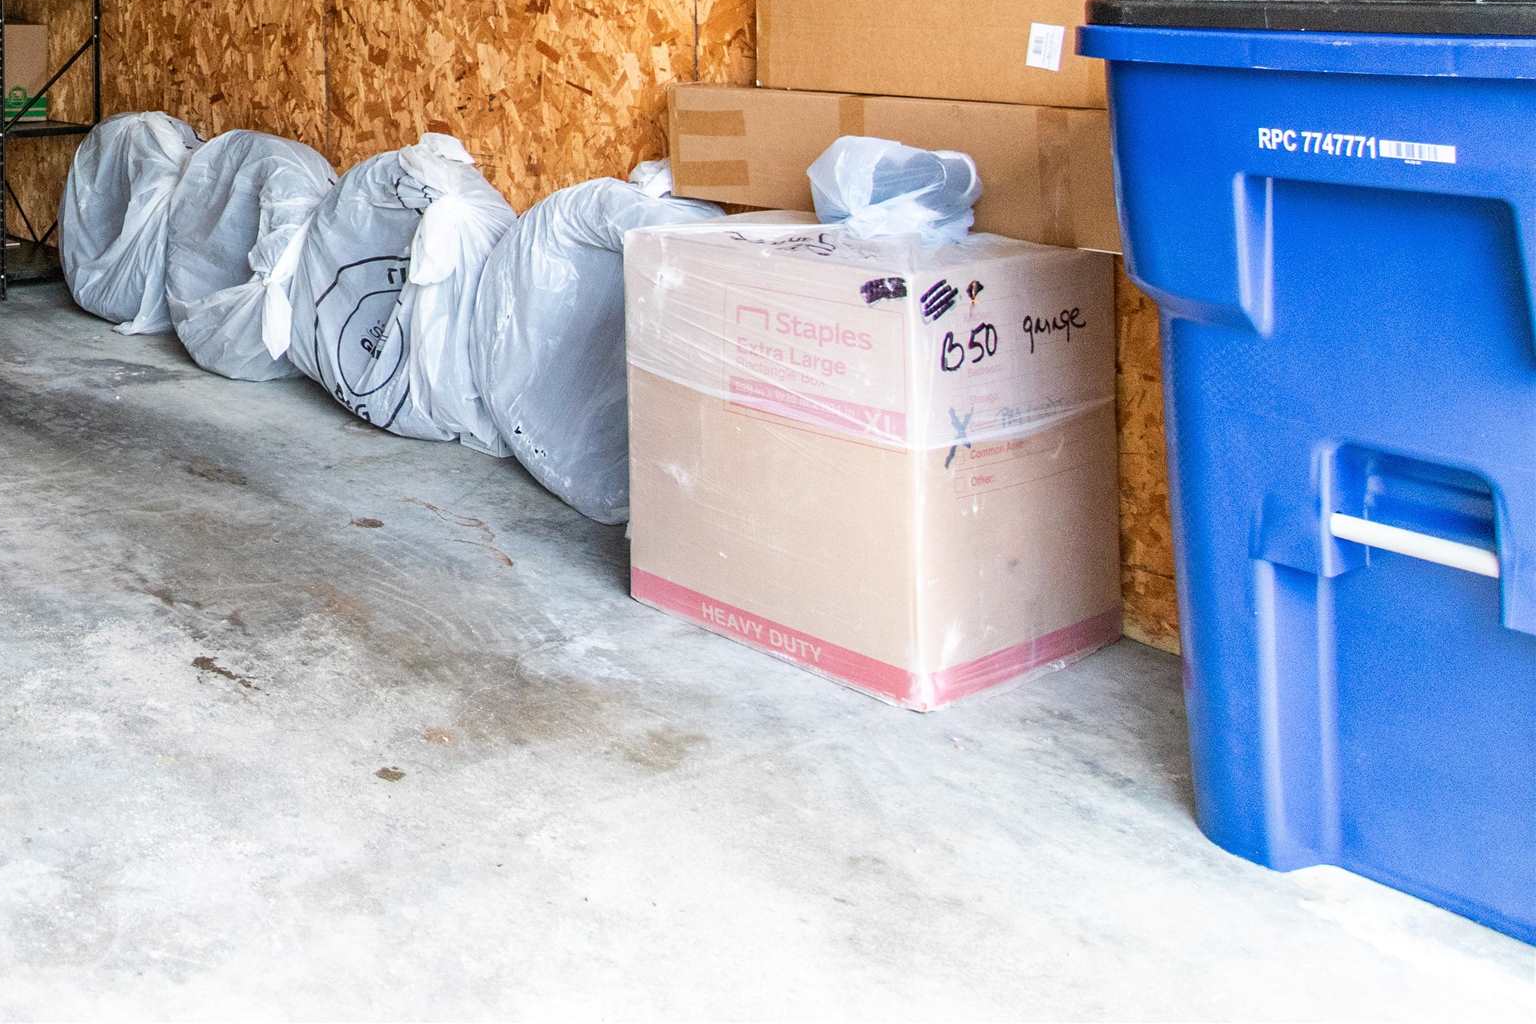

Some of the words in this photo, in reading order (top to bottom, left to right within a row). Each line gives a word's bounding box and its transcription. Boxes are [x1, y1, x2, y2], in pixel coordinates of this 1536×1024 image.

[1258, 127, 1297, 152] RPC
[1301, 131, 1377, 160] 7747771
[775, 311, 874, 351] Staples
[735, 335, 785, 362] Extra
[789, 346, 849, 377] Large
[968, 443, 1009, 461] Common
[969, 474, 994, 488] Other
[700, 601, 765, 640] HEAVY
[768, 625, 823, 663] DUTY
